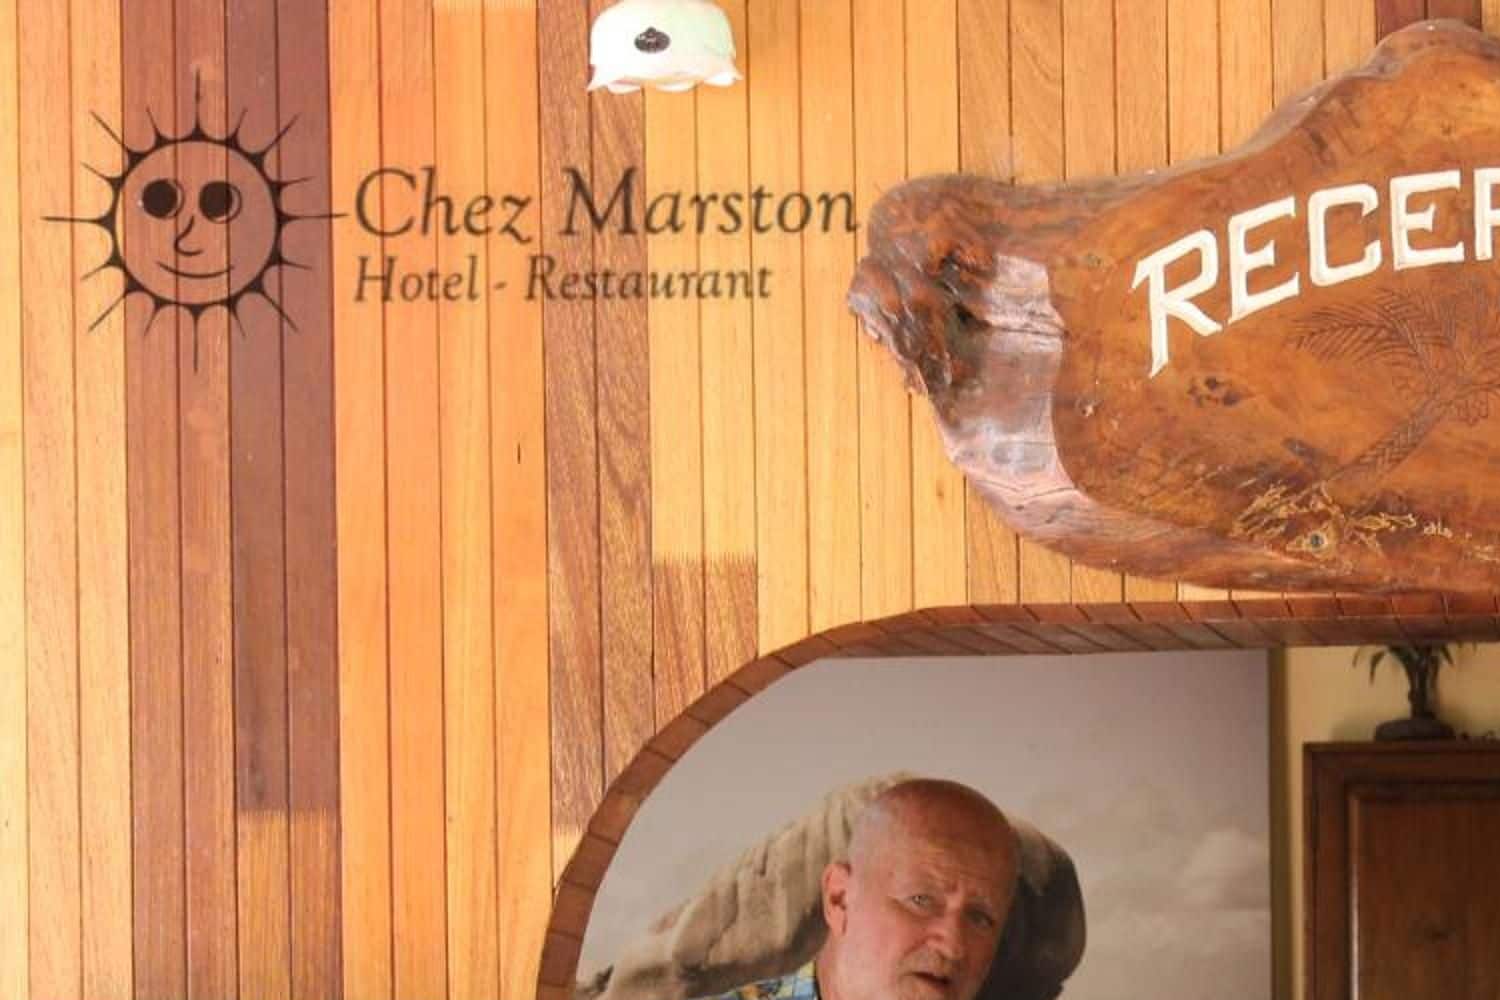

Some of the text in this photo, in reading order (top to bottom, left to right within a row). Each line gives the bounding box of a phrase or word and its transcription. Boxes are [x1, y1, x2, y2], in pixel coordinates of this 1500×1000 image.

[354, 166, 862, 244] Chez Marston
[353, 254, 481, 303] Hotel
[526, 254, 773, 303] Restaurant
